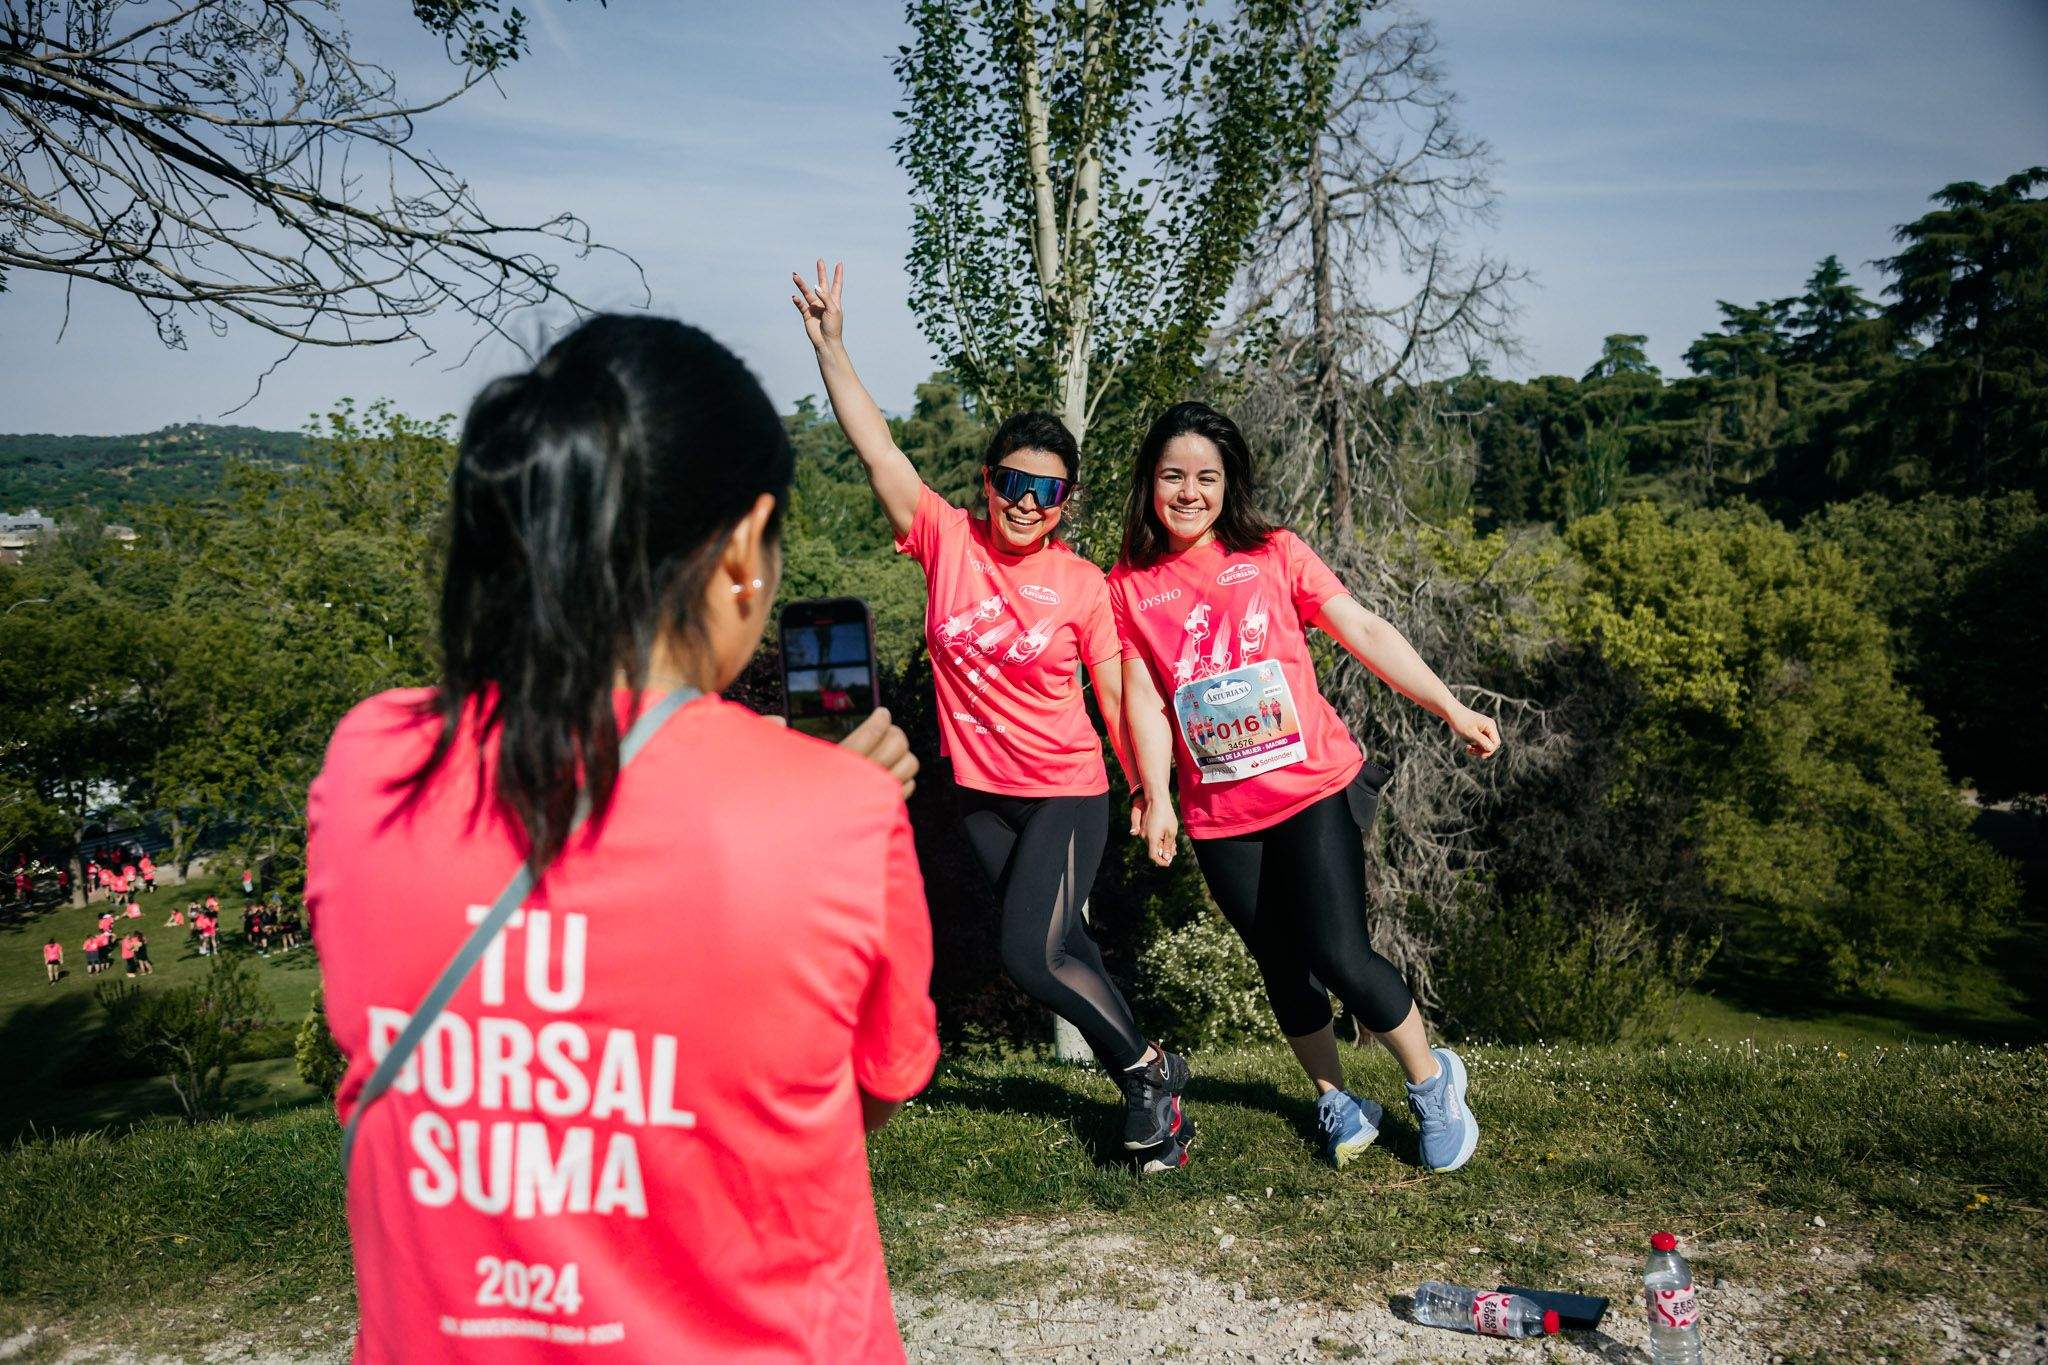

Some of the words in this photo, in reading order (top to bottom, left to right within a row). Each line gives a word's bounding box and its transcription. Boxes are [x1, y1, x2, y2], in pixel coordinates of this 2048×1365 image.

[1138, 588, 1182, 611] OYSHO
[1208, 686, 1249, 702] ASTURIANA
[1216, 715, 1259, 739] 016
[1225, 753, 1235, 761] DE
[1233, 751, 1242, 759] LA
[1241, 745, 1262, 757] MUJER
[1265, 738, 1288, 750] MADRID
[1228, 739, 1254, 750] 34576
[1260, 752, 1292, 765] Santander
[466, 904, 588, 1012] TU
[367, 1006, 696, 1128] DORSAL
[409, 1113, 648, 1219] SUMA
[475, 1255, 583, 1315] 2024
